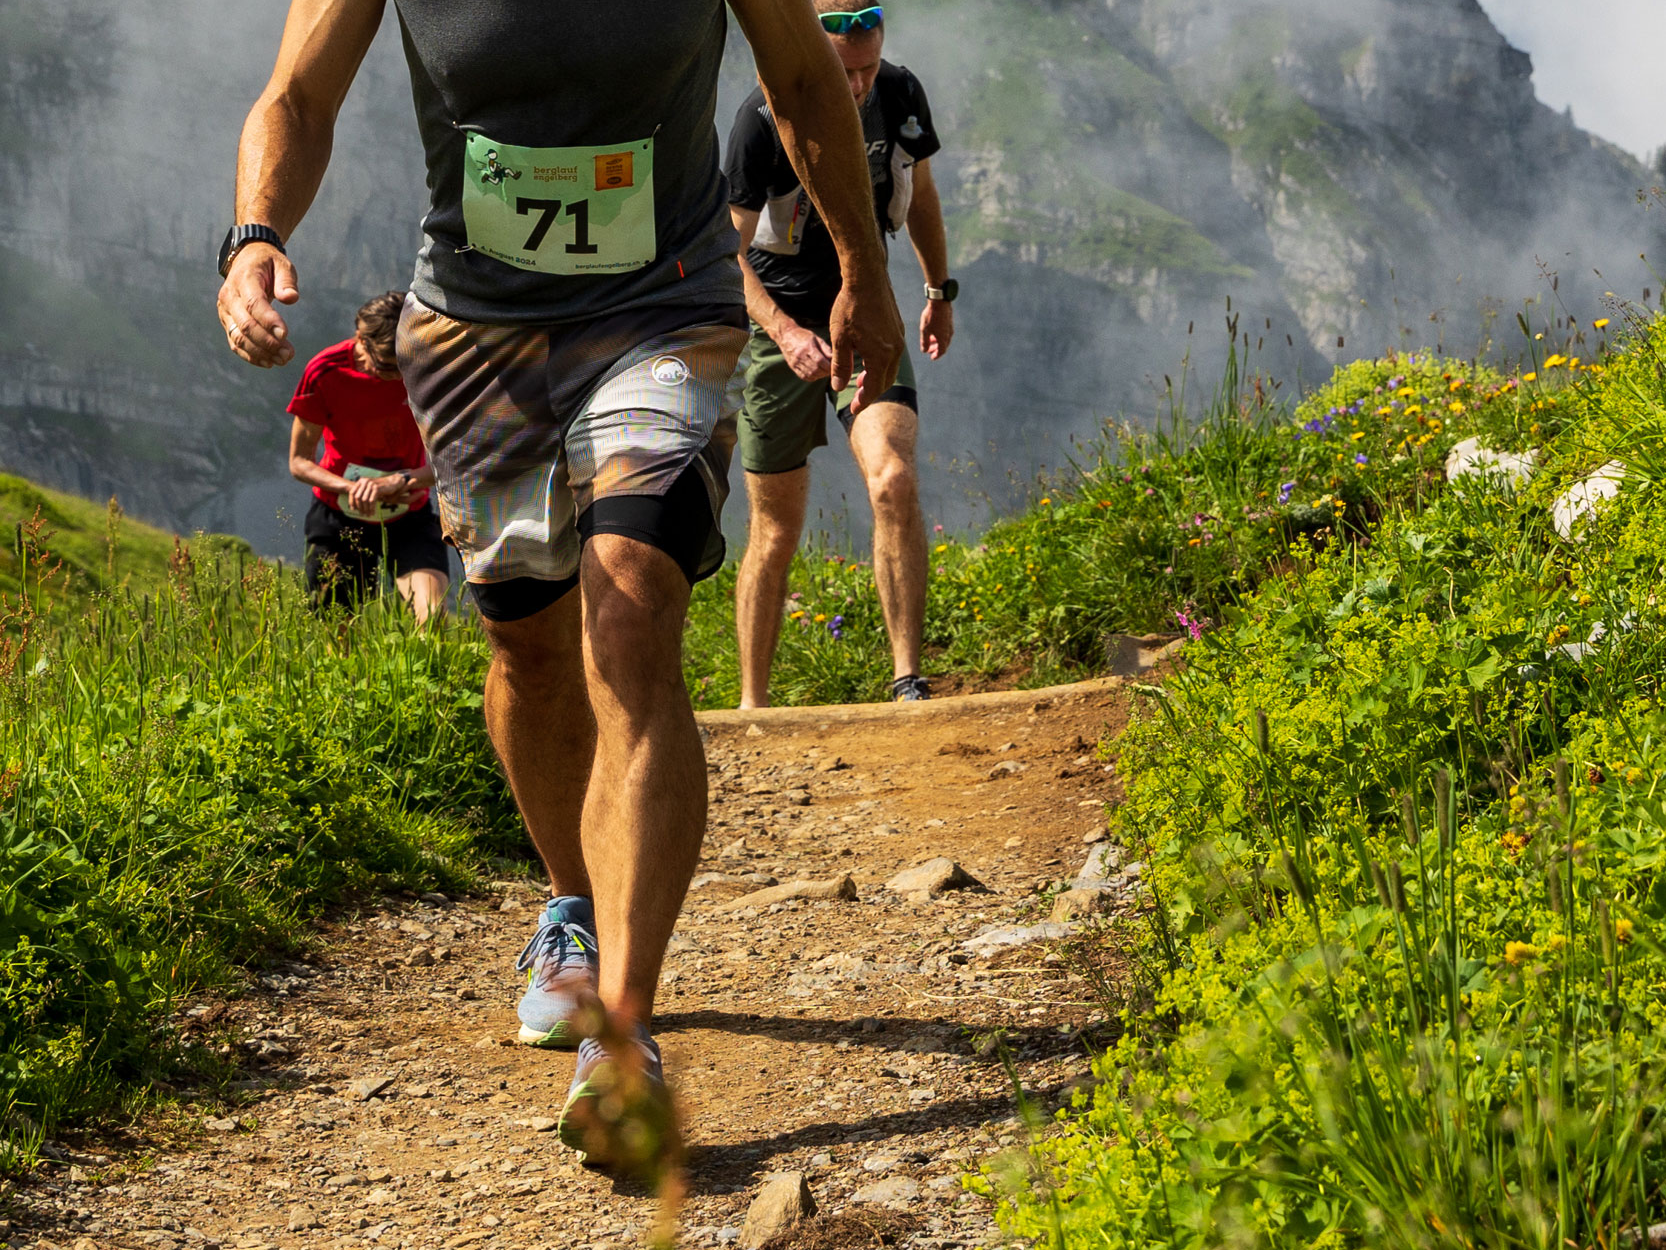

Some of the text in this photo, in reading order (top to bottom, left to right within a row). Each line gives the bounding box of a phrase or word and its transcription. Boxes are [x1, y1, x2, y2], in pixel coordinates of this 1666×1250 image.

[533, 165, 578, 176] berglauf
[533, 174, 578, 183] engelberg
[516, 196, 598, 254] 71
[489, 248, 514, 260] August
[515, 256, 536, 266] 2024
[575, 260, 641, 269] berglaufengelberg.ch
